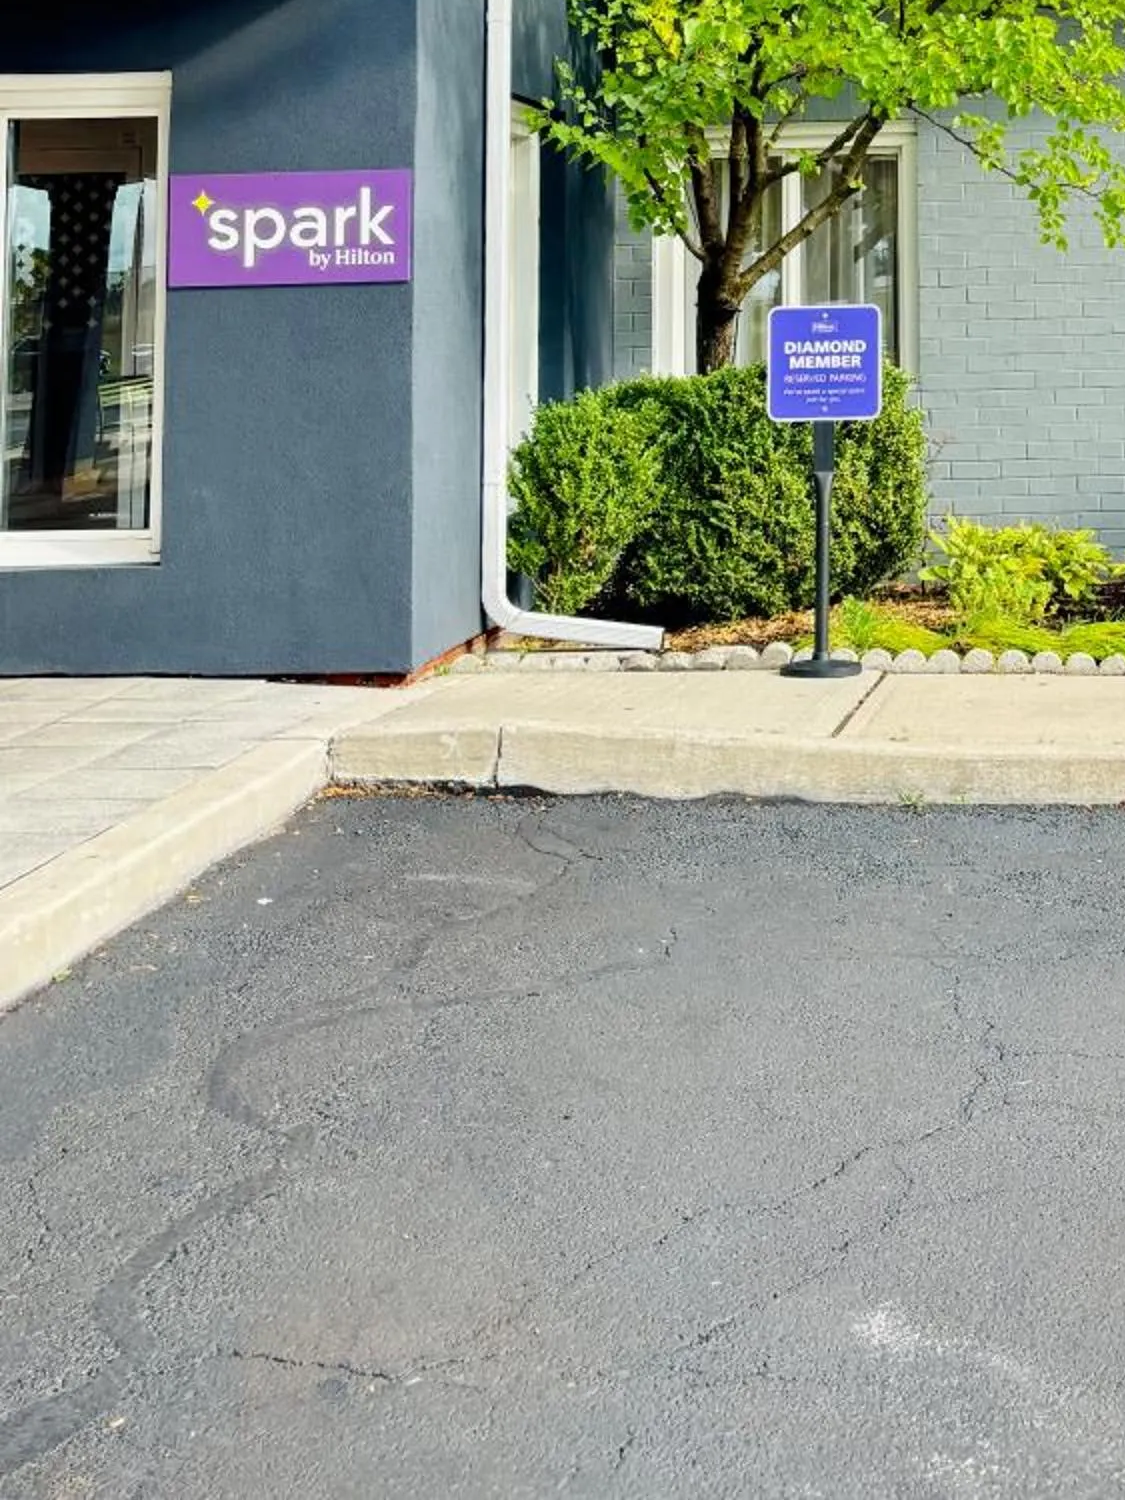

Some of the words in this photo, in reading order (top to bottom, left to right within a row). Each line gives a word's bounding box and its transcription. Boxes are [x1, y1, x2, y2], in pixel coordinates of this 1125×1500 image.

[208, 186, 395, 268] spark
[309, 250, 331, 270] by
[335, 249, 395, 265] Hilton
[784, 340, 867, 354] DIAMOND
[789, 355, 862, 369] MEMBER
